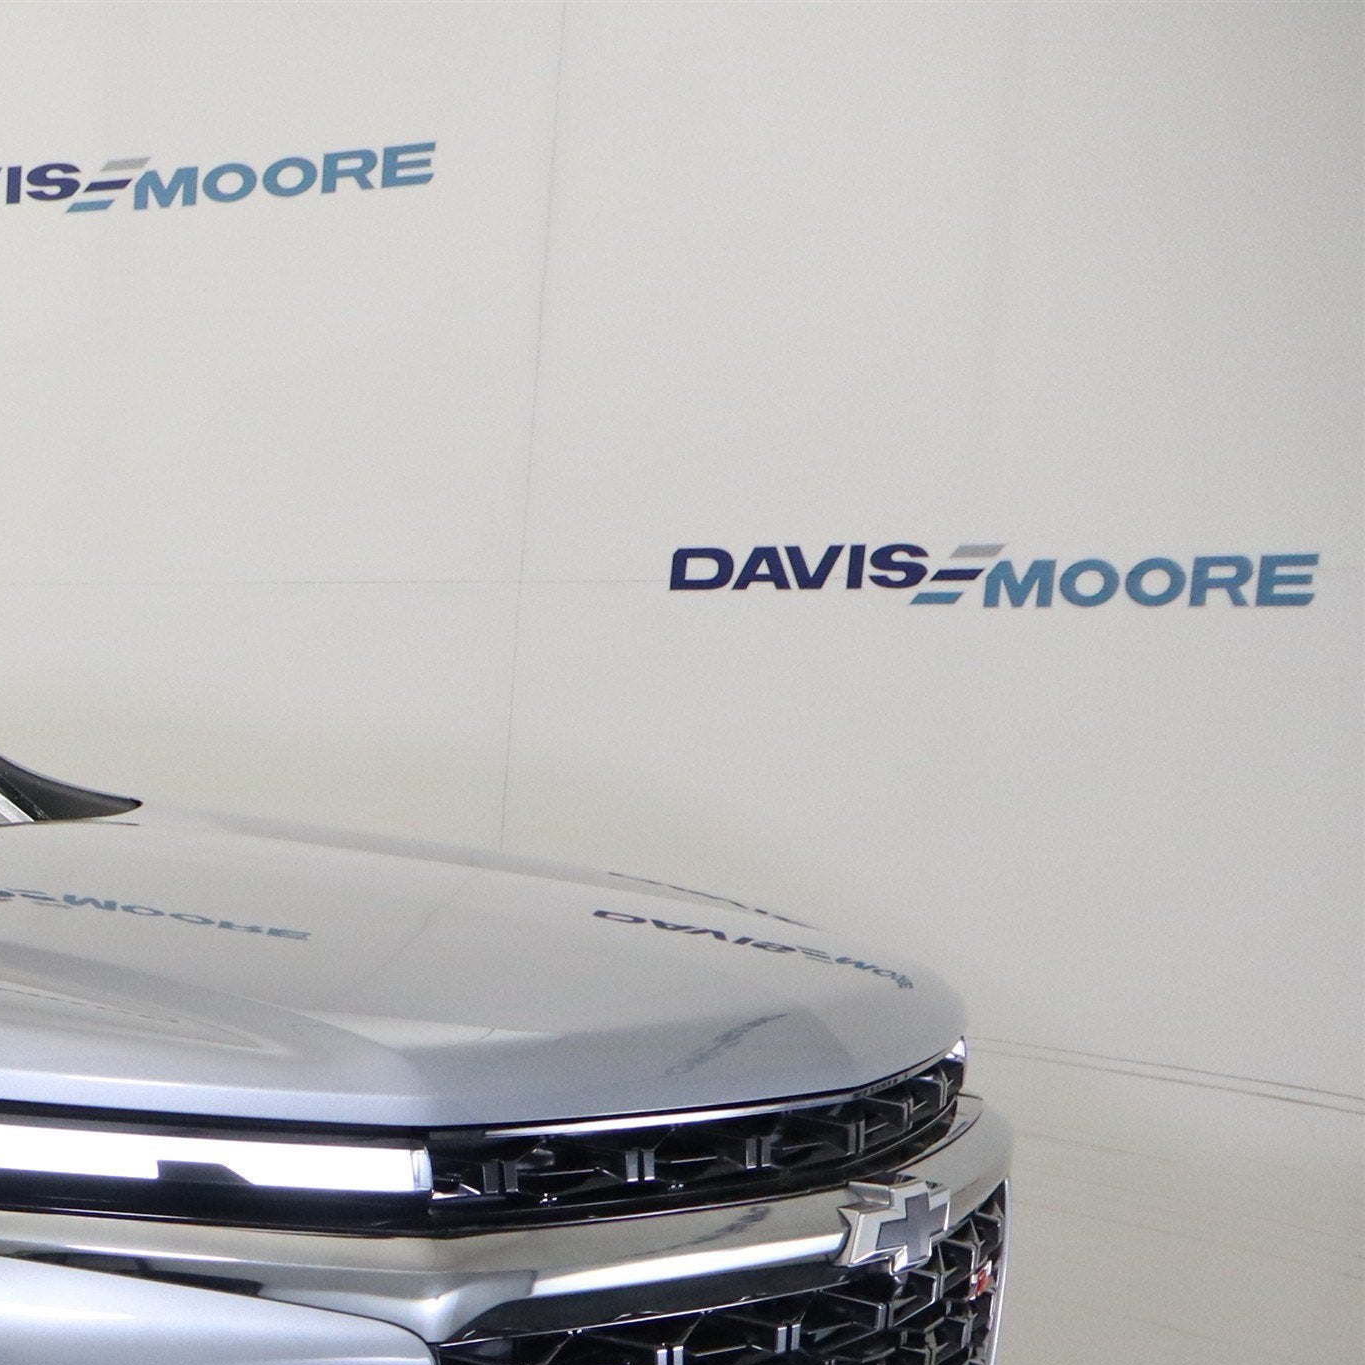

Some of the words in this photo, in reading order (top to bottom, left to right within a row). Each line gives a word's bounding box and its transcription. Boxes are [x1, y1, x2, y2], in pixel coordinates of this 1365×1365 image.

[133, 141, 437, 211] MOORE
[669, 543, 930, 591] DAVIS
[982, 553, 1321, 609] MOORE
